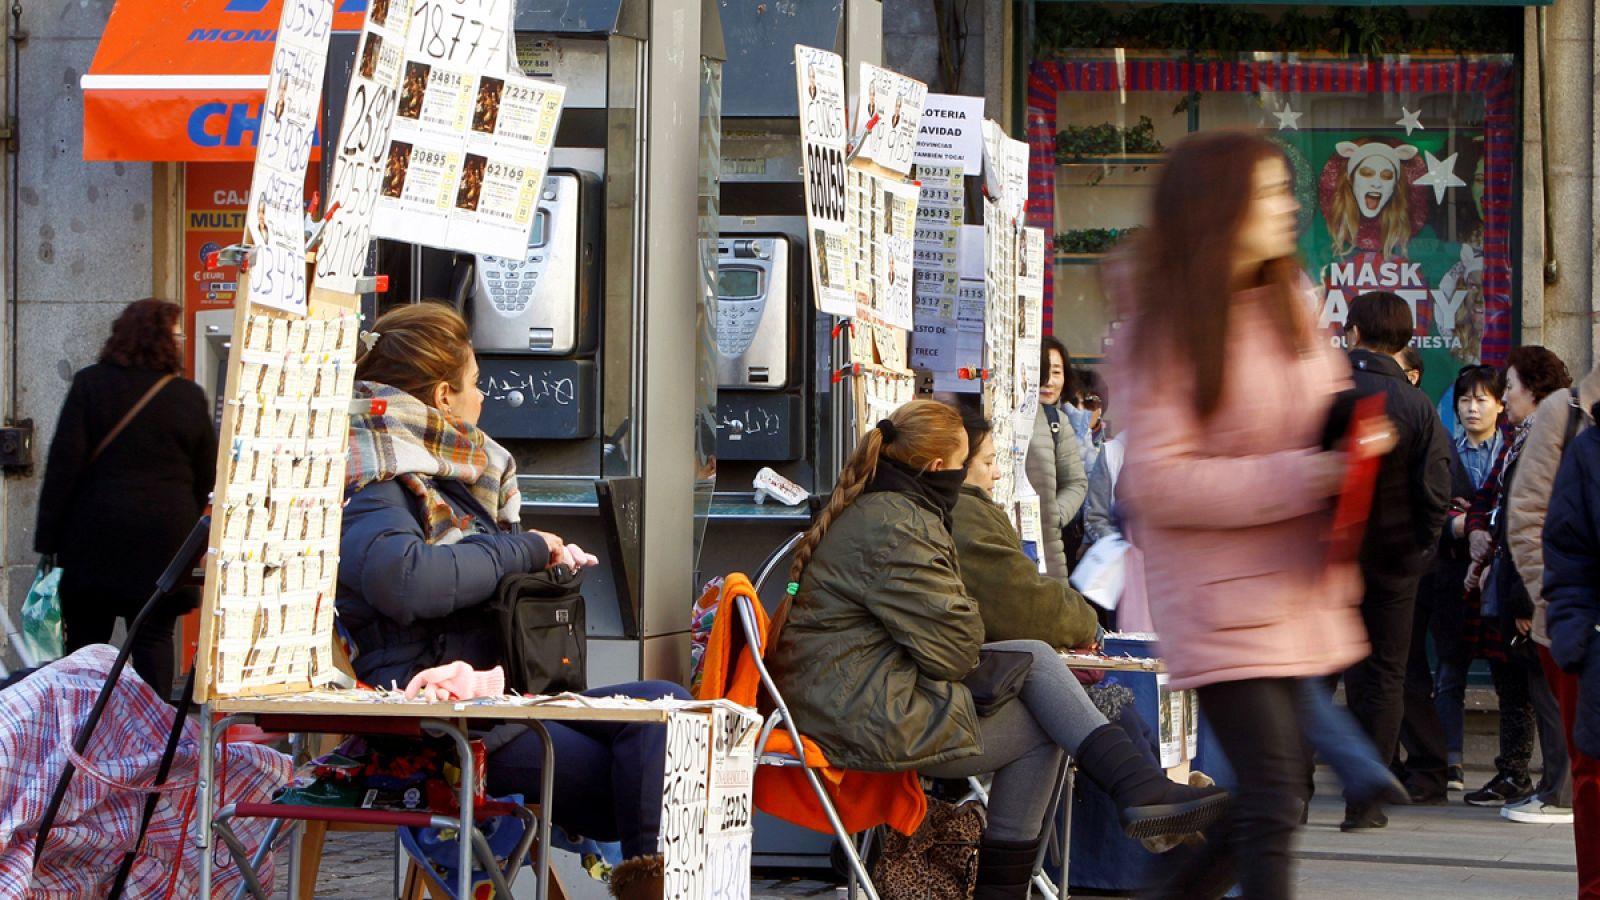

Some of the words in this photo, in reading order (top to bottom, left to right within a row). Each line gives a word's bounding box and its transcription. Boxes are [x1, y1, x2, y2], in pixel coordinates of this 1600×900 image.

[413, 1, 504, 68] 18777
[430, 70, 462, 86] 34814
[505, 85, 544, 102] 72217
[920, 126, 962, 136] AVIDAD
[916, 141, 953, 149] ROVINCIAS
[412, 150, 446, 167] 30895
[487, 163, 523, 181] 62169
[807, 142, 845, 222] 88059
[1331, 262, 1423, 287] MASK
[1317, 289, 1469, 329] ATY
[1408, 336, 1463, 349] FIESTA
[915, 347, 939, 357] TRECE
[663, 714, 708, 776] 30895
[664, 803, 705, 867] 34814
